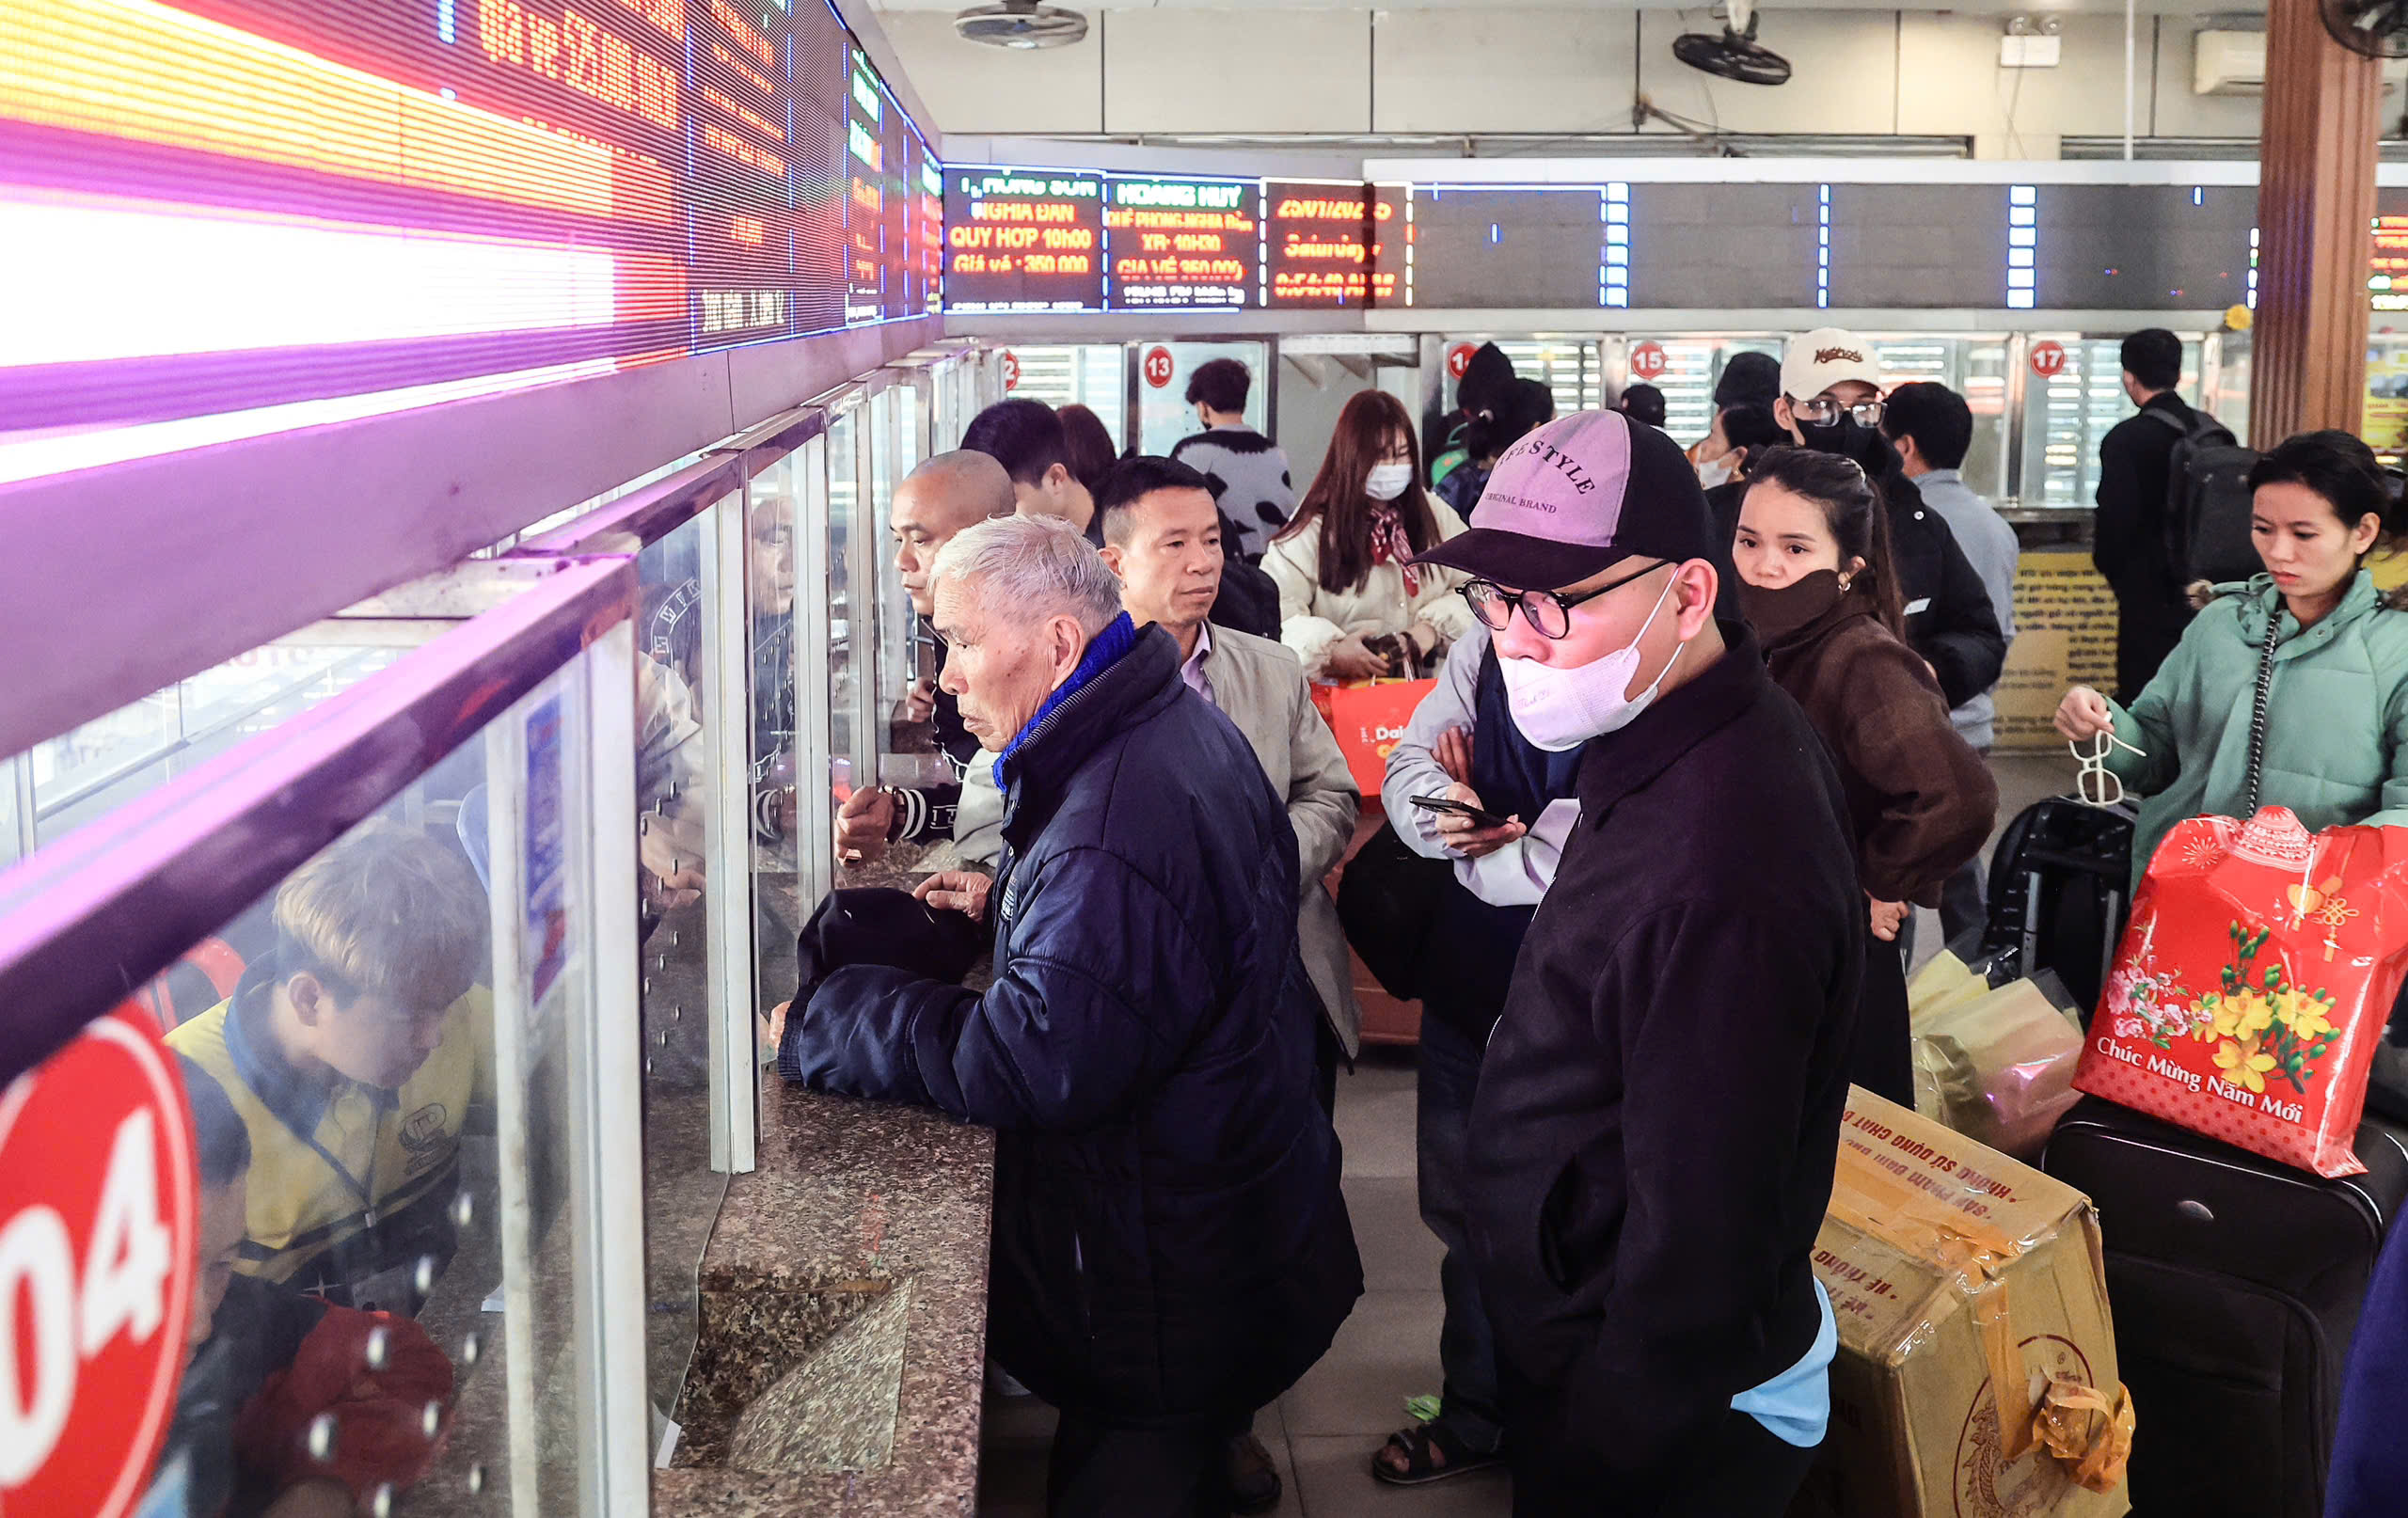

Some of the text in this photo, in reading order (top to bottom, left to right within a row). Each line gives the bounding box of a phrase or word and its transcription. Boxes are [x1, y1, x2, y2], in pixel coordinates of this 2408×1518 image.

[1148, 356, 1170, 377] 13
[1635, 352, 1663, 371] 15
[2035, 349, 2063, 368] 17
[1519, 498, 1557, 514] BRAND
[2097, 1036, 2304, 1123] Chúc Mừng Năm Mới
[0, 1106, 171, 1488] 04
